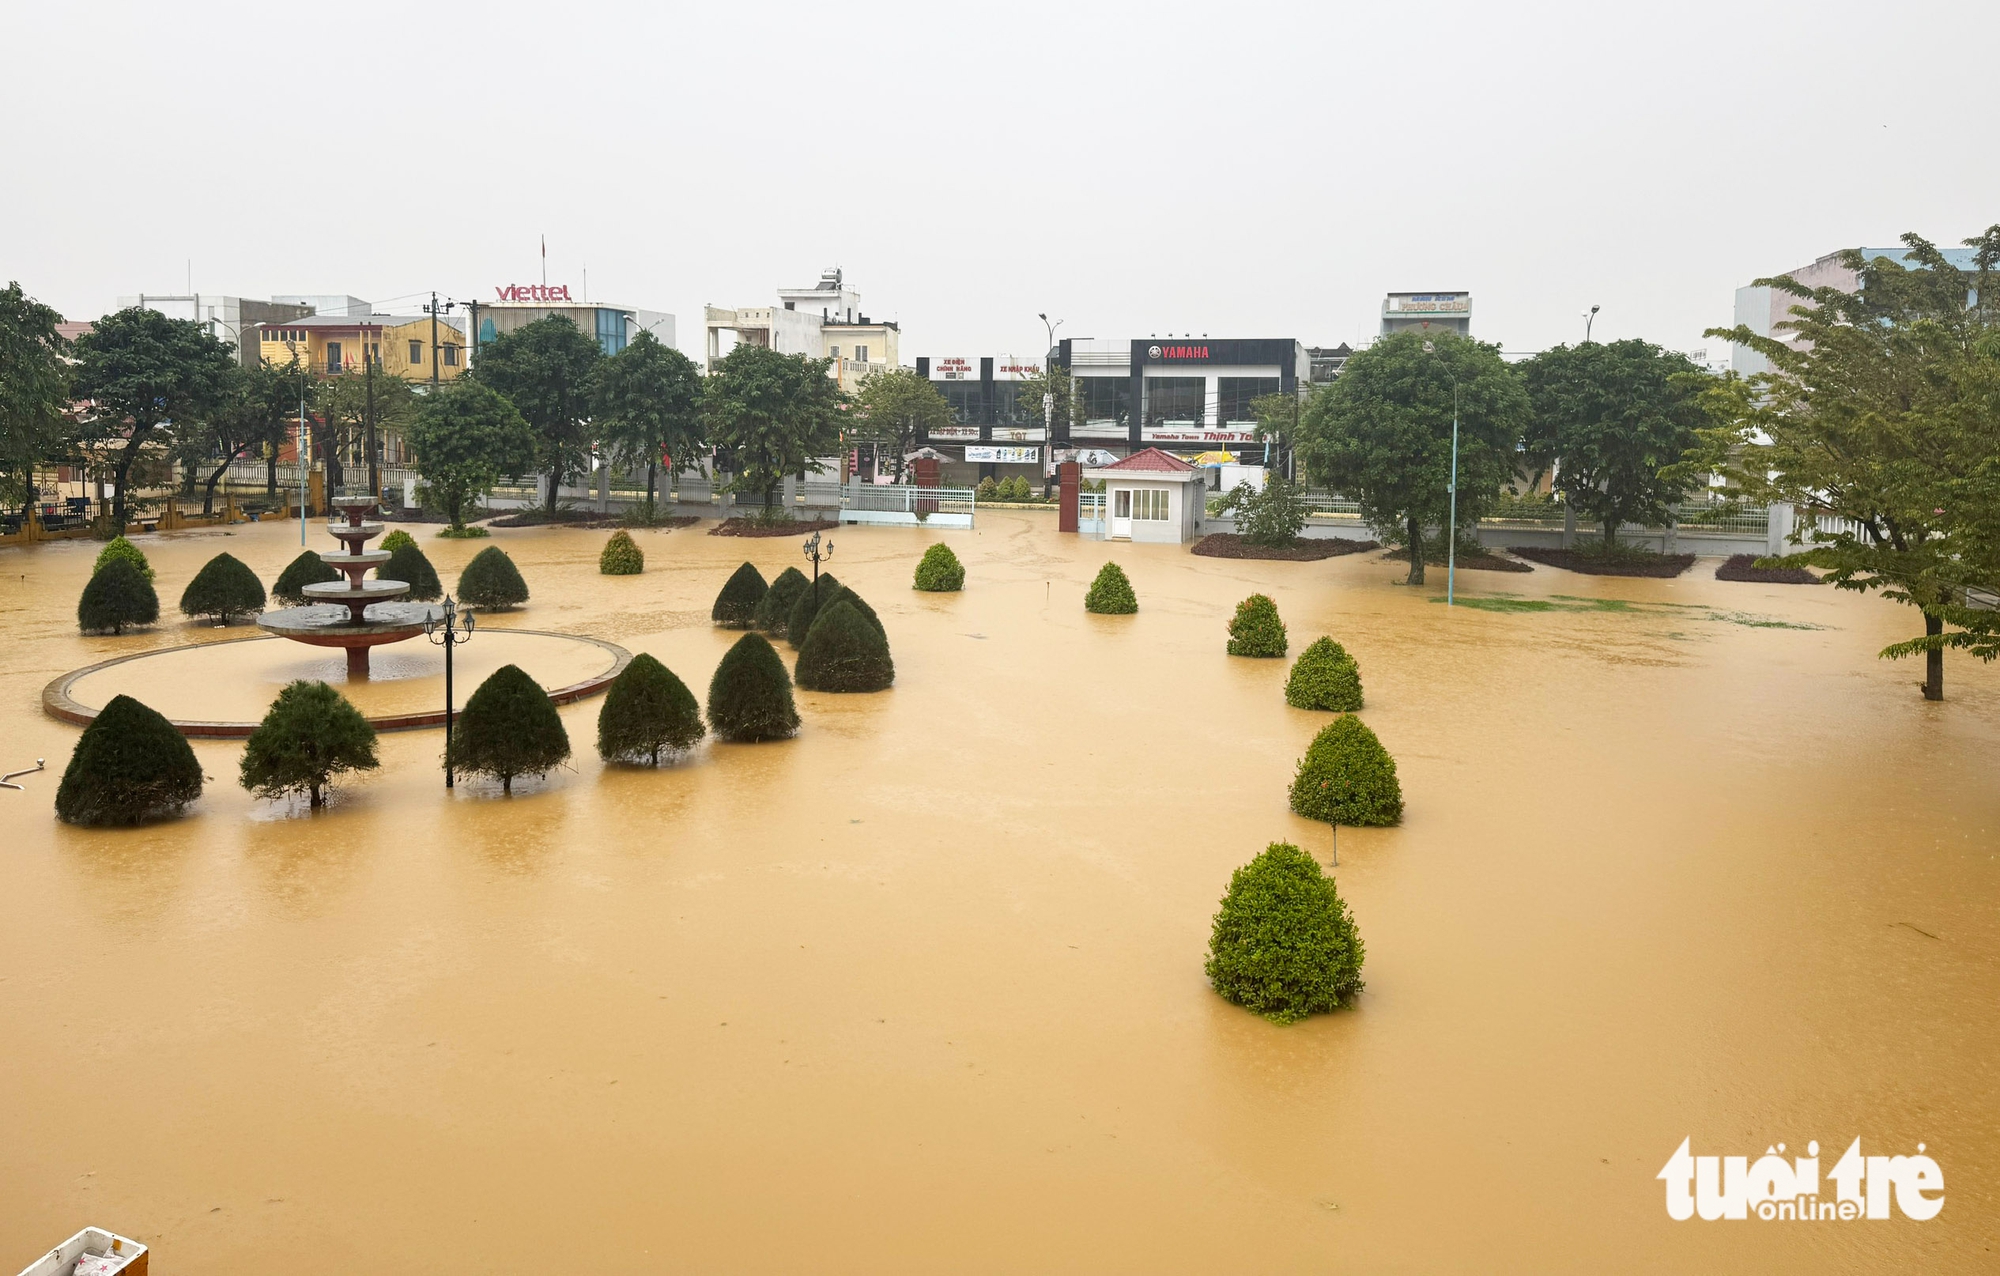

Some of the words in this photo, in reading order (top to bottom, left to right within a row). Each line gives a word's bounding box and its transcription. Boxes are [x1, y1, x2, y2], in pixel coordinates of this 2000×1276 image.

[495, 284, 572, 301] viettel
[1162, 346, 1209, 358] YAMAHA
[1203, 432, 1235, 442] Thịnh
